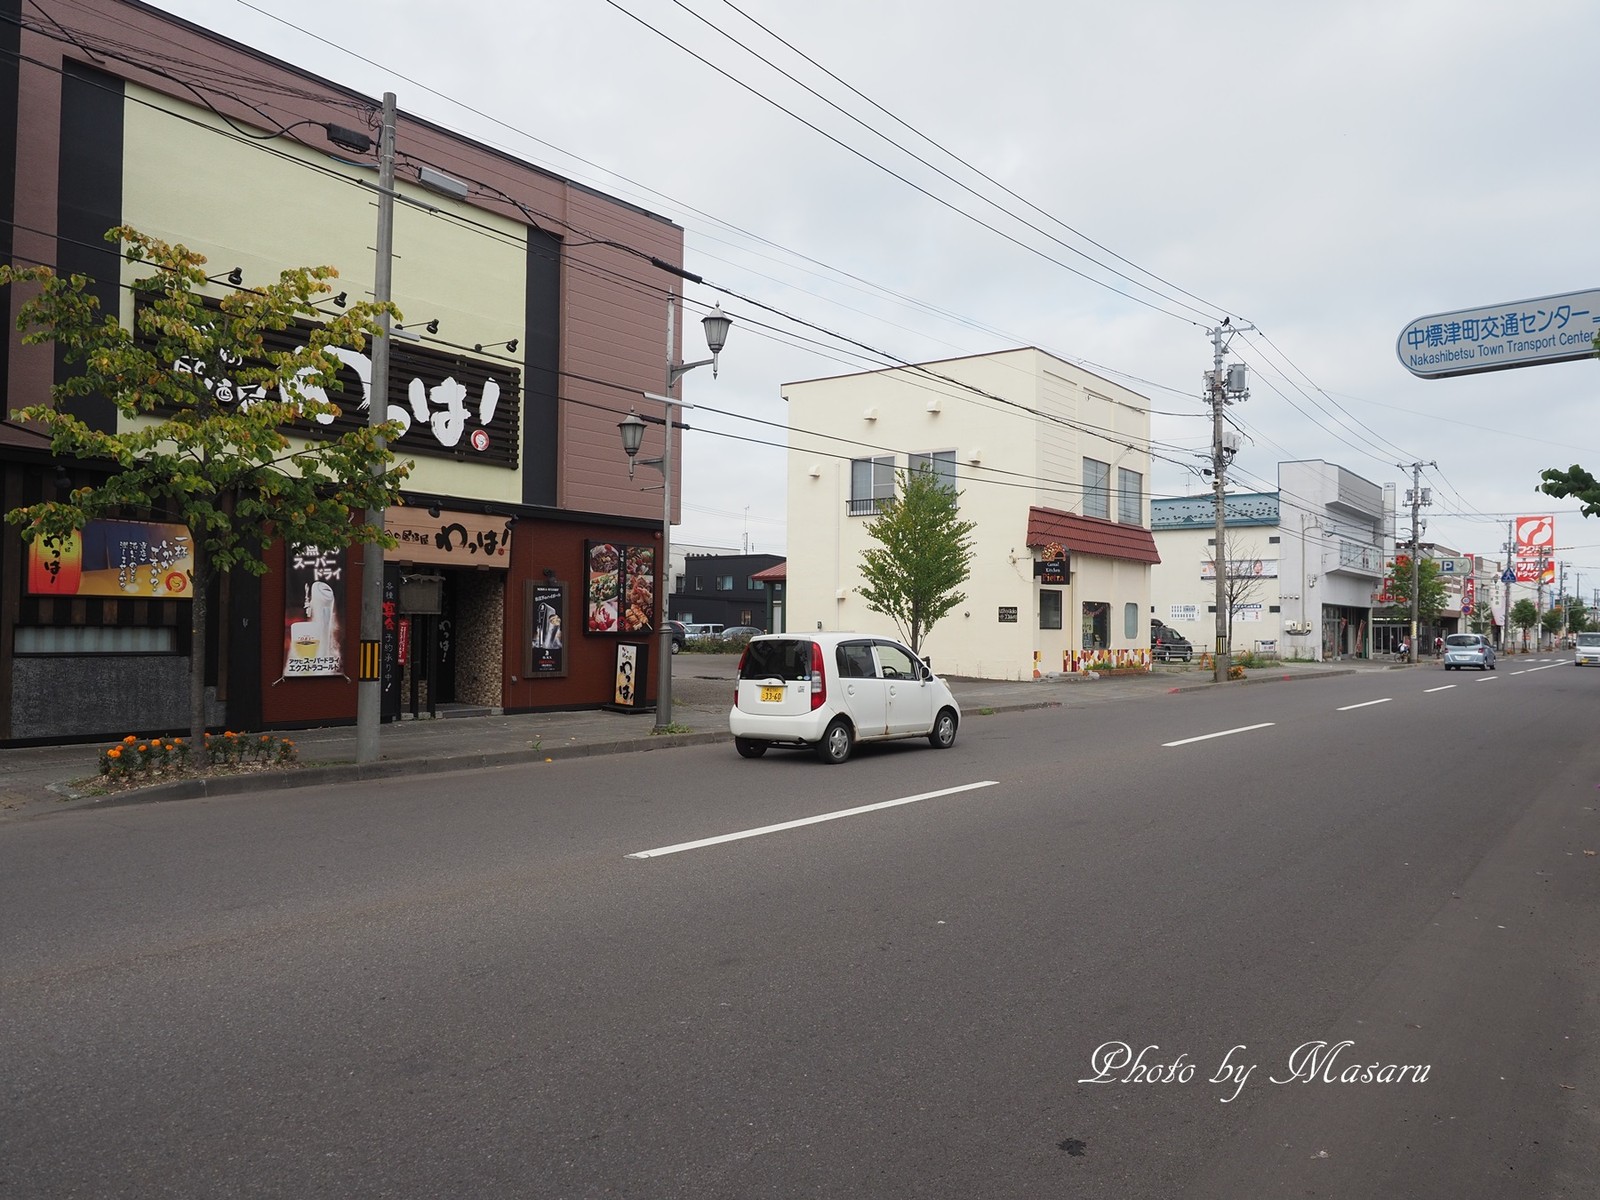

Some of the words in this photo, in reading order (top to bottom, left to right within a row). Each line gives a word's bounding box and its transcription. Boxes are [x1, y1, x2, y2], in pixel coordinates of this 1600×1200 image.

[1407, 305, 1590, 350] 中標津町交通センター
[1410, 347, 1475, 366] Nakashibetsu
[1477, 344, 1504, 357] Town
[1507, 335, 1556, 353] Transport
[1559, 331, 1594, 346] Center
[293, 556, 336, 570] スーパー
[1444, 562, 1452, 570] P
[313, 568, 342, 581] ドライ
[1042, 573, 1064, 582] Pietra
[765, 692, 782, 701] 33-60
